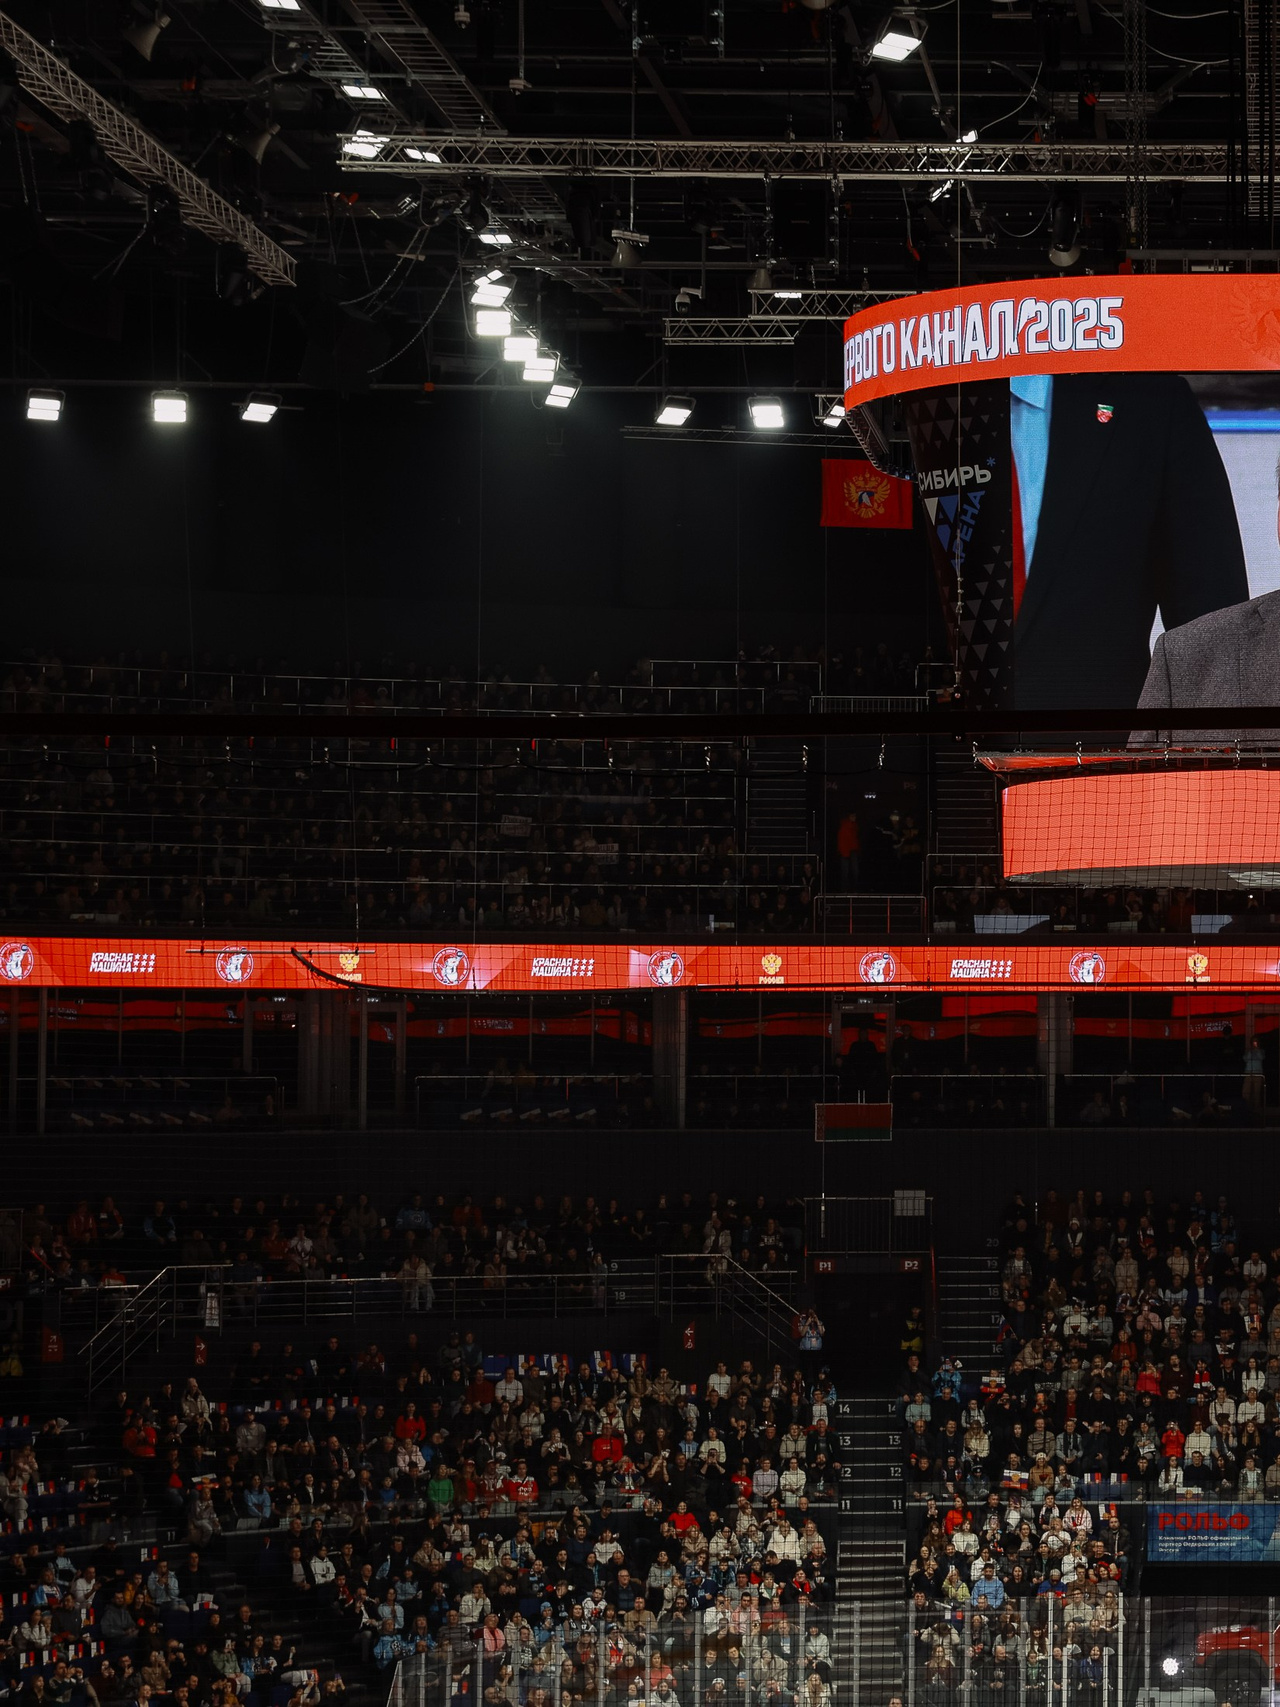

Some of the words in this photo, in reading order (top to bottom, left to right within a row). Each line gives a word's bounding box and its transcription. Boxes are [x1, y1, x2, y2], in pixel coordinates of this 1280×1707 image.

[844, 322, 896, 391] ЕРВОГО
[1026, 297, 1124, 353] 2025
[918, 464, 992, 492] СИБИРЬ
[950, 490, 986, 577] АРЕНА
[92, 953, 133, 961] КРАСНАЯ
[90, 961, 132, 972] МАШИНА
[533, 958, 573, 966] КРАСНАЯ
[952, 960, 991, 968] КРАСНАЯ
[531, 966, 572, 976] МАШИНА
[950, 968, 990, 978] МАШИНА
[819, 1262, 832, 1270] P1
[905, 1261, 918, 1270] P2
[839, 1404, 850, 1413] 14
[839, 1436, 850, 1445] 13
[889, 1436, 900, 1445] 13
[890, 1467, 901, 1476] 12
[841, 1500, 850, 1509] 11
[892, 1500, 902, 1509] 11
[1158, 1512, 1250, 1531] РОЛЬФ
